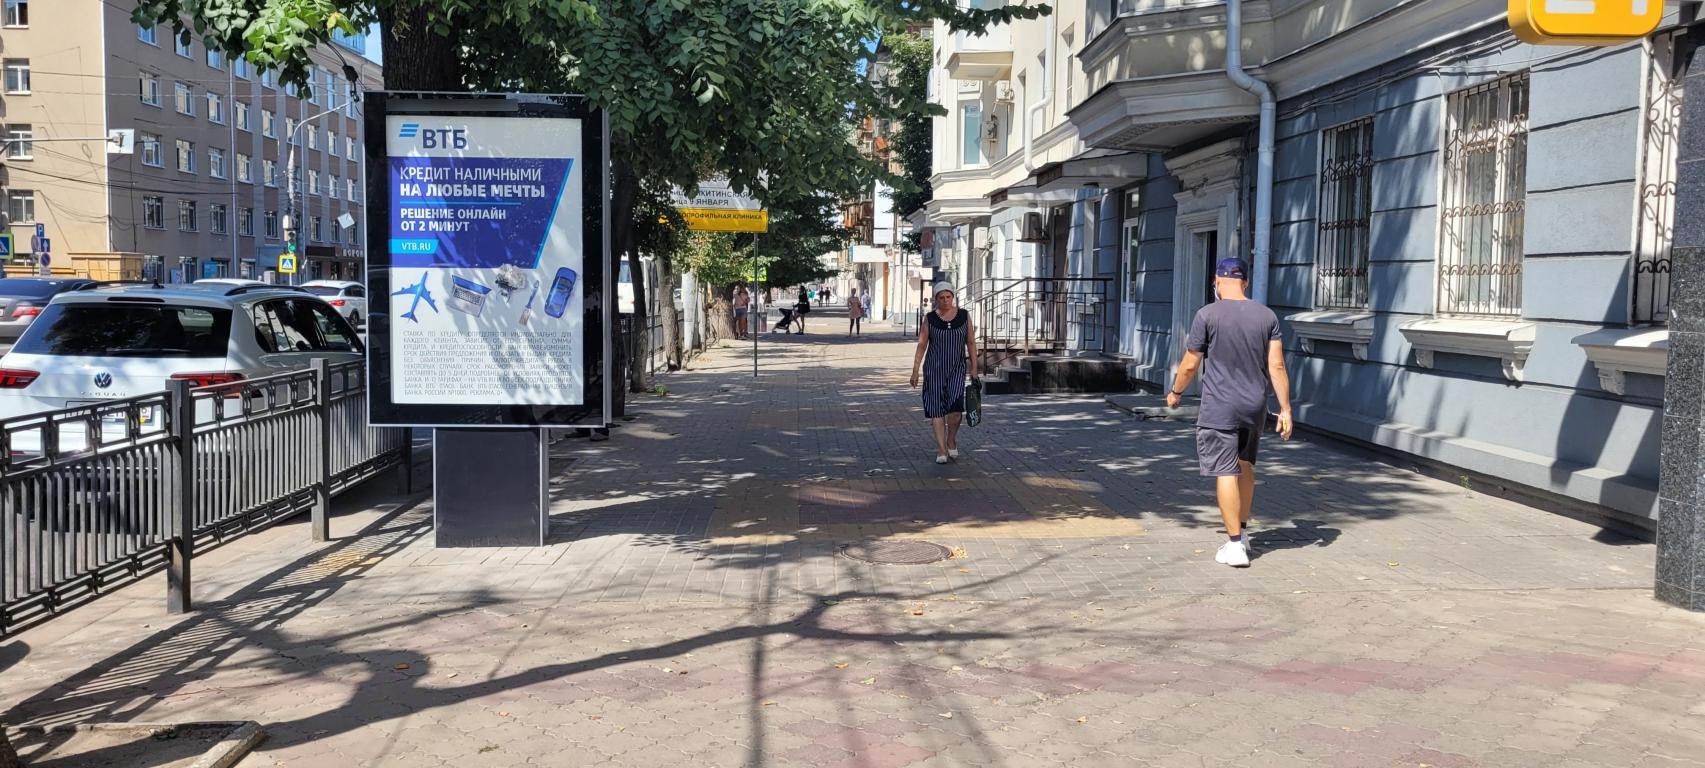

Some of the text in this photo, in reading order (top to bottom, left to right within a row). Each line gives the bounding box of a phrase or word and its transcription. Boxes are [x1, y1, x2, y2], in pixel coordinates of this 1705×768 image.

[422, 129, 467, 149] ВТБ
[400, 166, 541, 182] КРЕДИТ НАЛИЧНЫМИ
[400, 184, 545, 198] НА ЛЮБЫЕ МЕЧТЫ
[697, 190, 749, 198] КИТИНСКАЯ
[696, 198, 728, 206] ЯНВАРЯ
[400, 206, 506, 219] РЕШЕНИЕ ОНЛАЙН
[401, 221, 470, 232] ОТ 2 МИНУТ
[401, 242, 431, 252] VTB.RU
